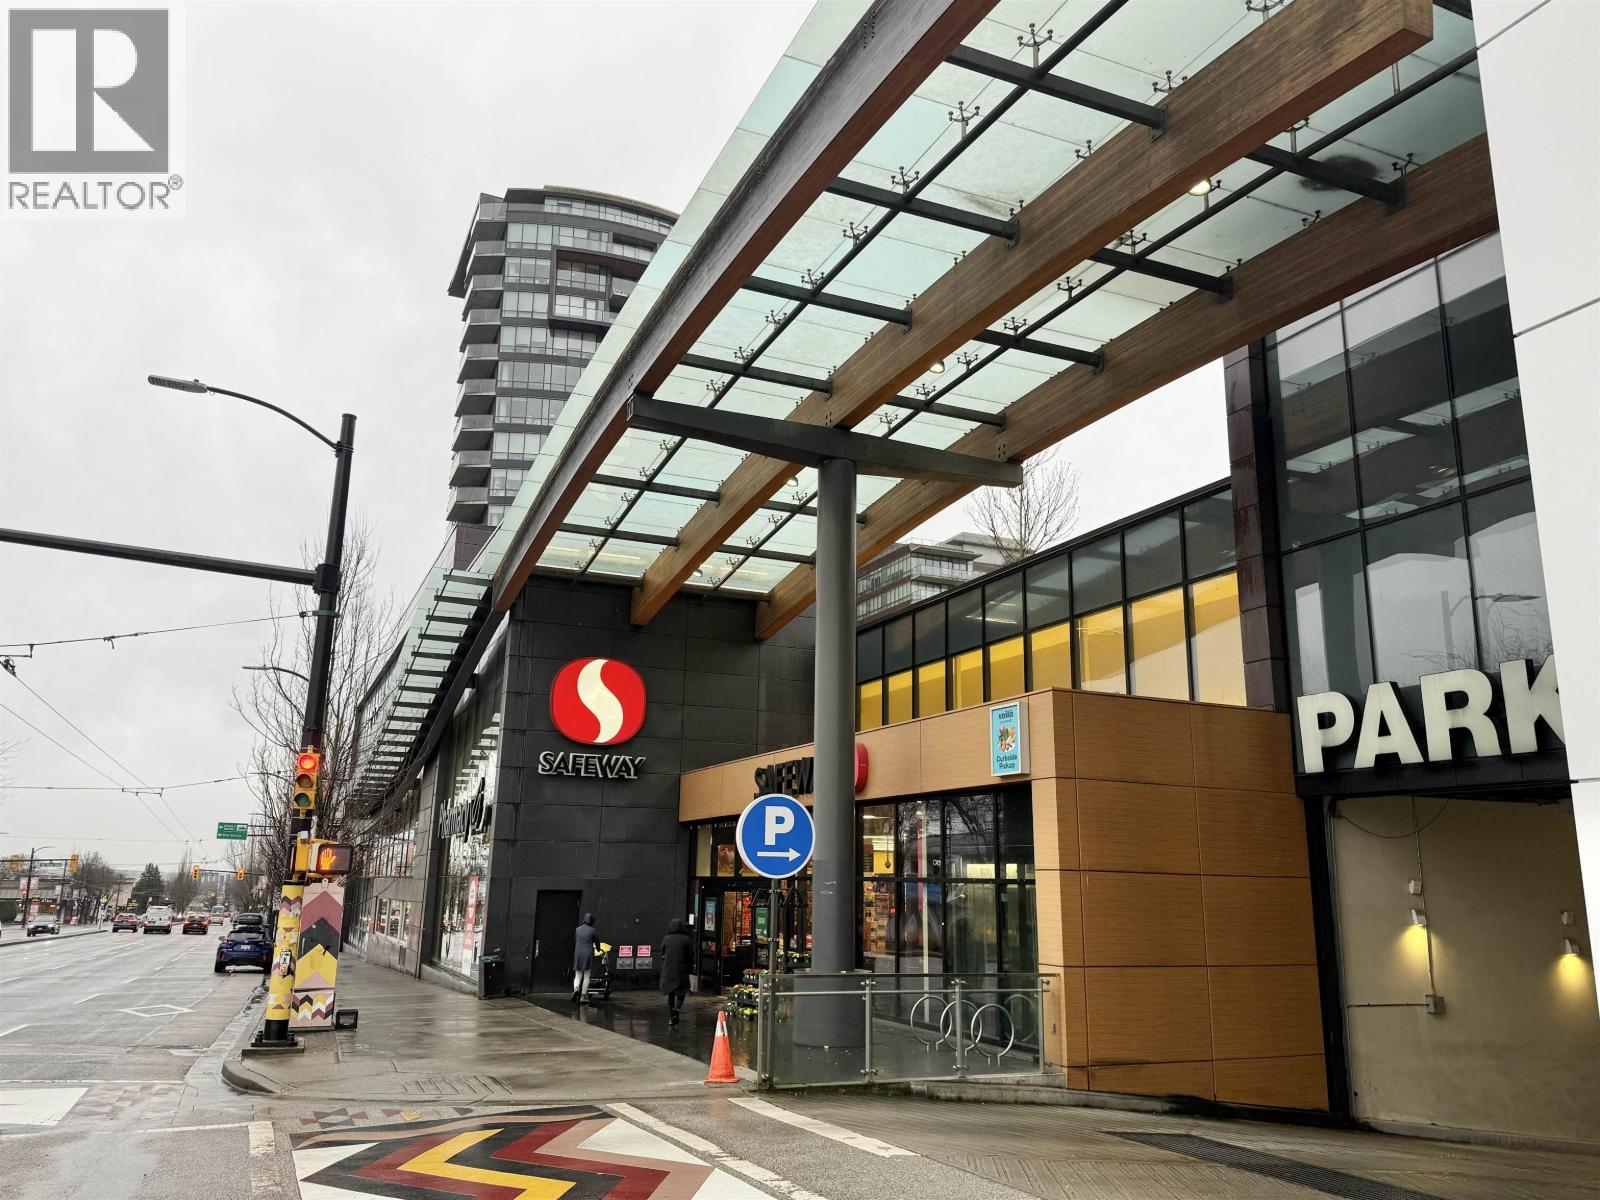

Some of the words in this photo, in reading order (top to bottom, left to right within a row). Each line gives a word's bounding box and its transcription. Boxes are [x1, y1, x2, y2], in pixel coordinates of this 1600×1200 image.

[1296, 654, 1567, 774] PARK
[538, 750, 647, 779] SAFEWAY
[764, 805, 795, 846] P
